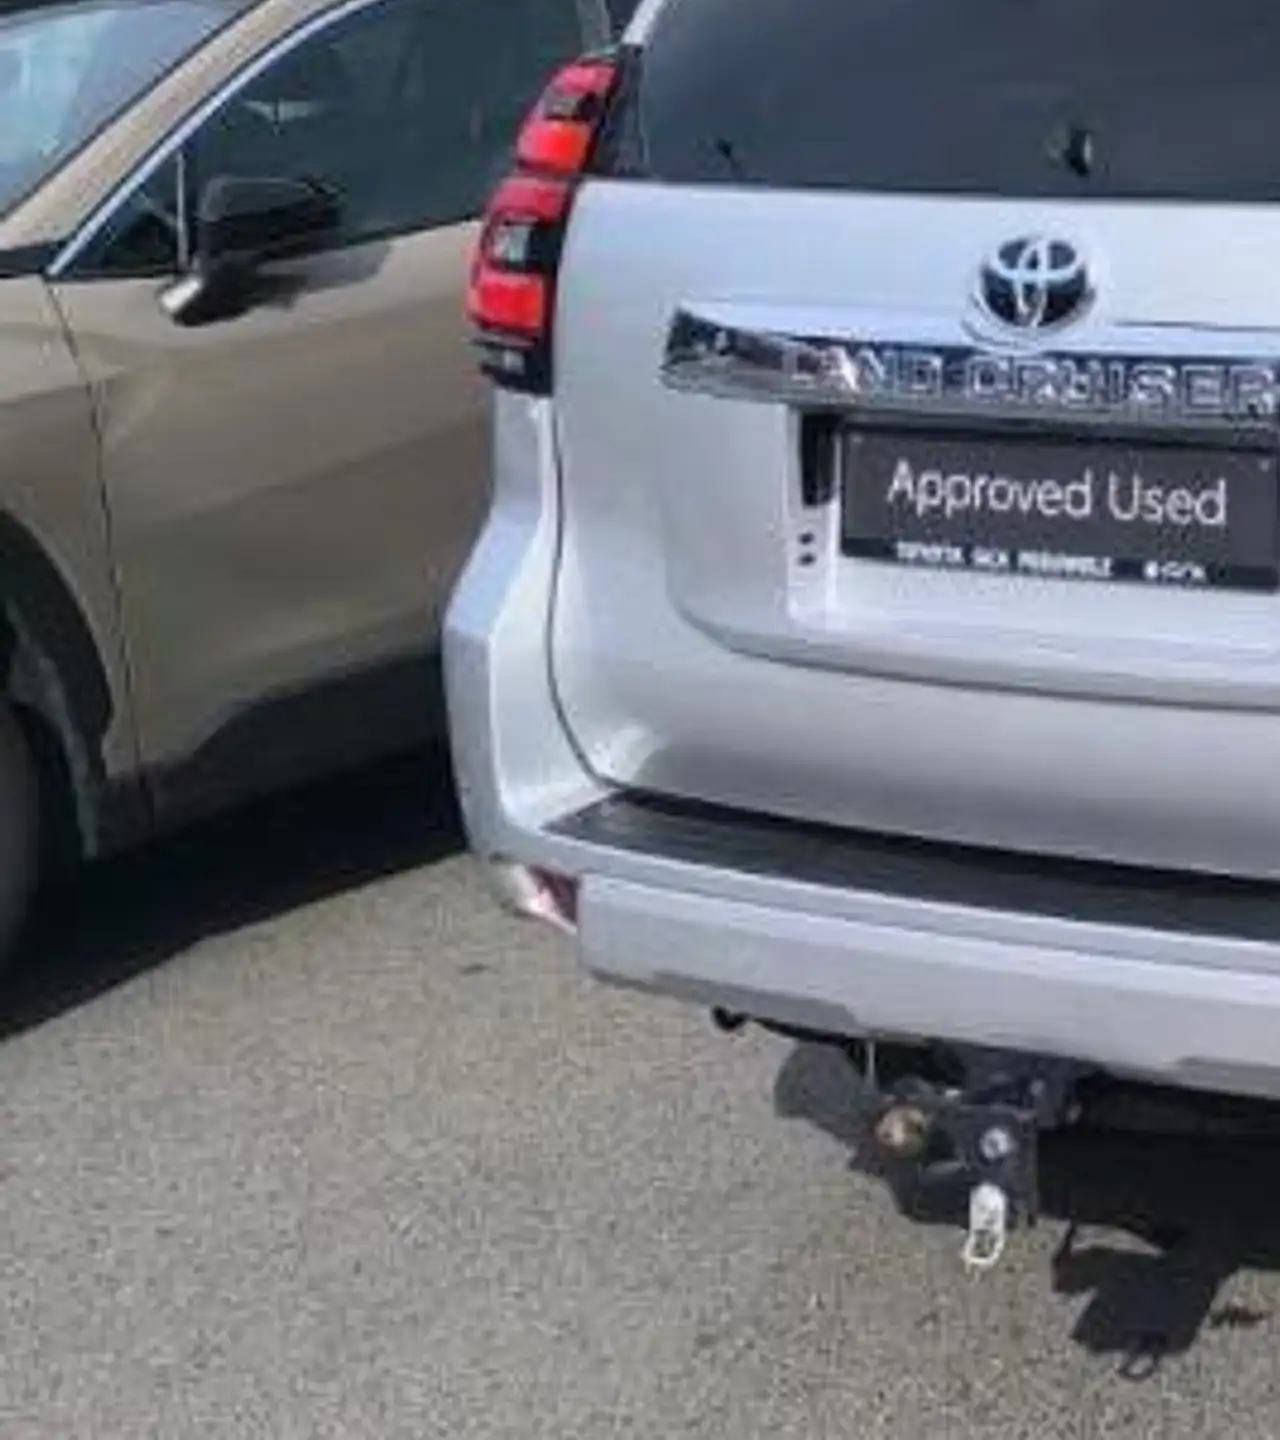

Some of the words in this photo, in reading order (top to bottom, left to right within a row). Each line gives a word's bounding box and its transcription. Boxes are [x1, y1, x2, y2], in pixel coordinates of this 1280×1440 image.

[782, 344, 942, 396] LAND
[966, 352, 1278, 416] CRUISER
[888, 458, 1094, 520] Approved
[1107, 468, 1228, 526] Used
